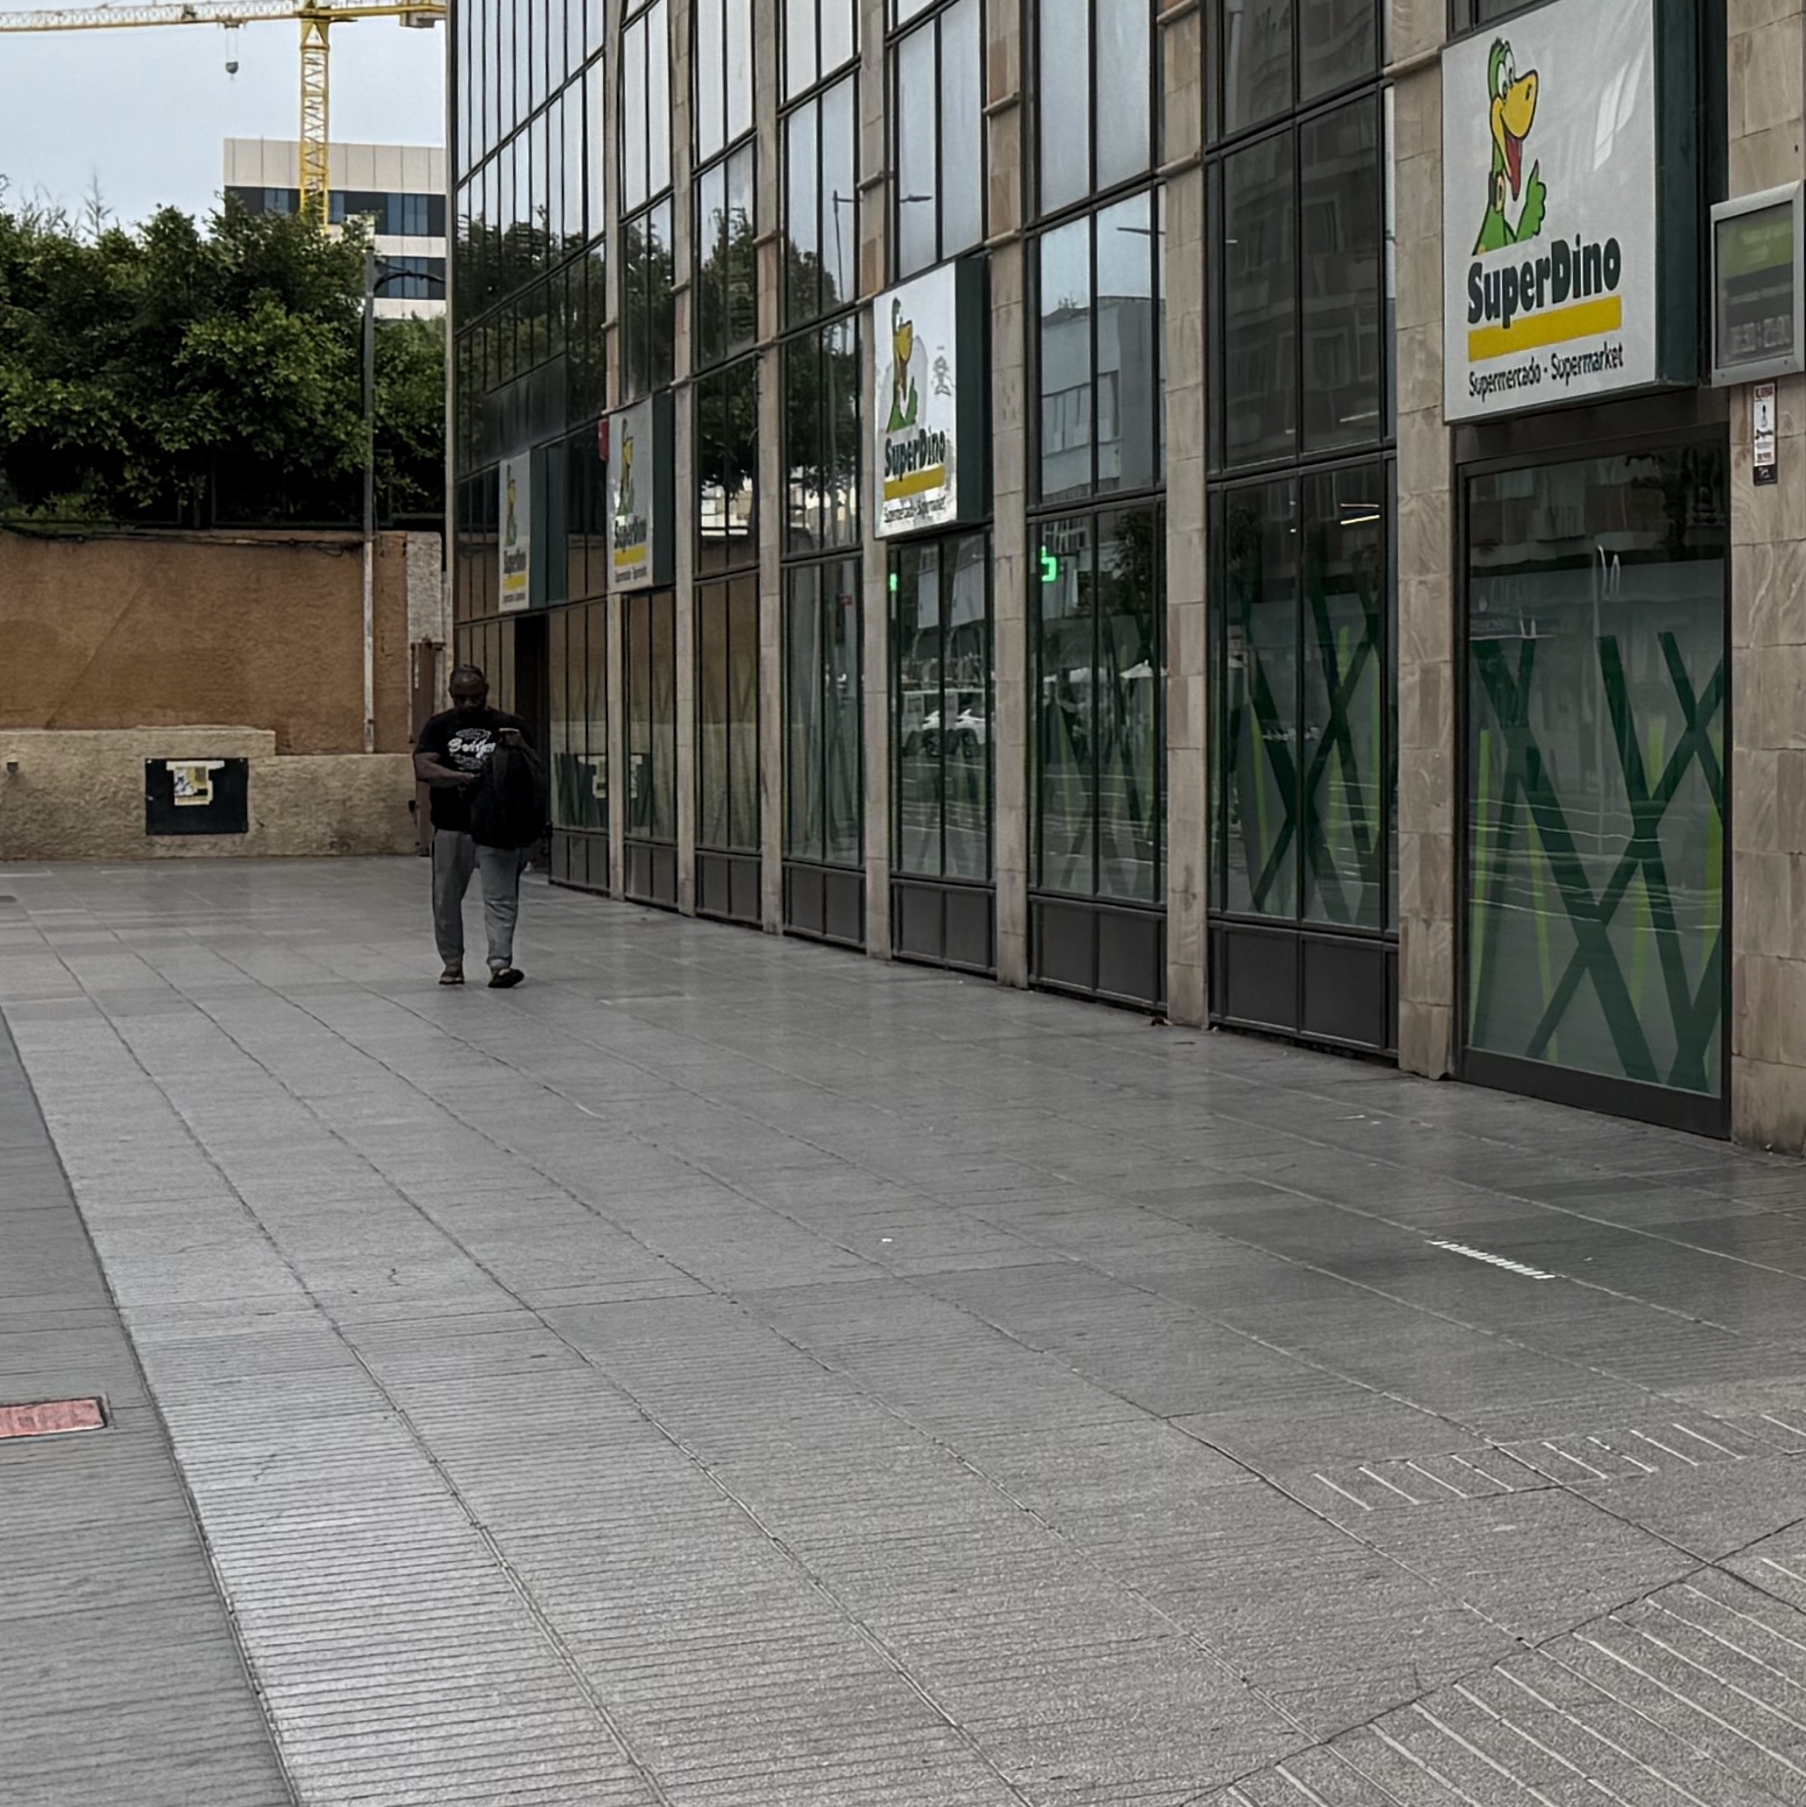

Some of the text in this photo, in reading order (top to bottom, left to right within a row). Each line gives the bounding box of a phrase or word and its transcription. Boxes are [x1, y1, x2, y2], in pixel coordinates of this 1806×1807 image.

[1467, 233, 1622, 329] SuperDino
[1469, 355, 1542, 403] Supermercado
[1550, 341, 1624, 387] Supermarket
